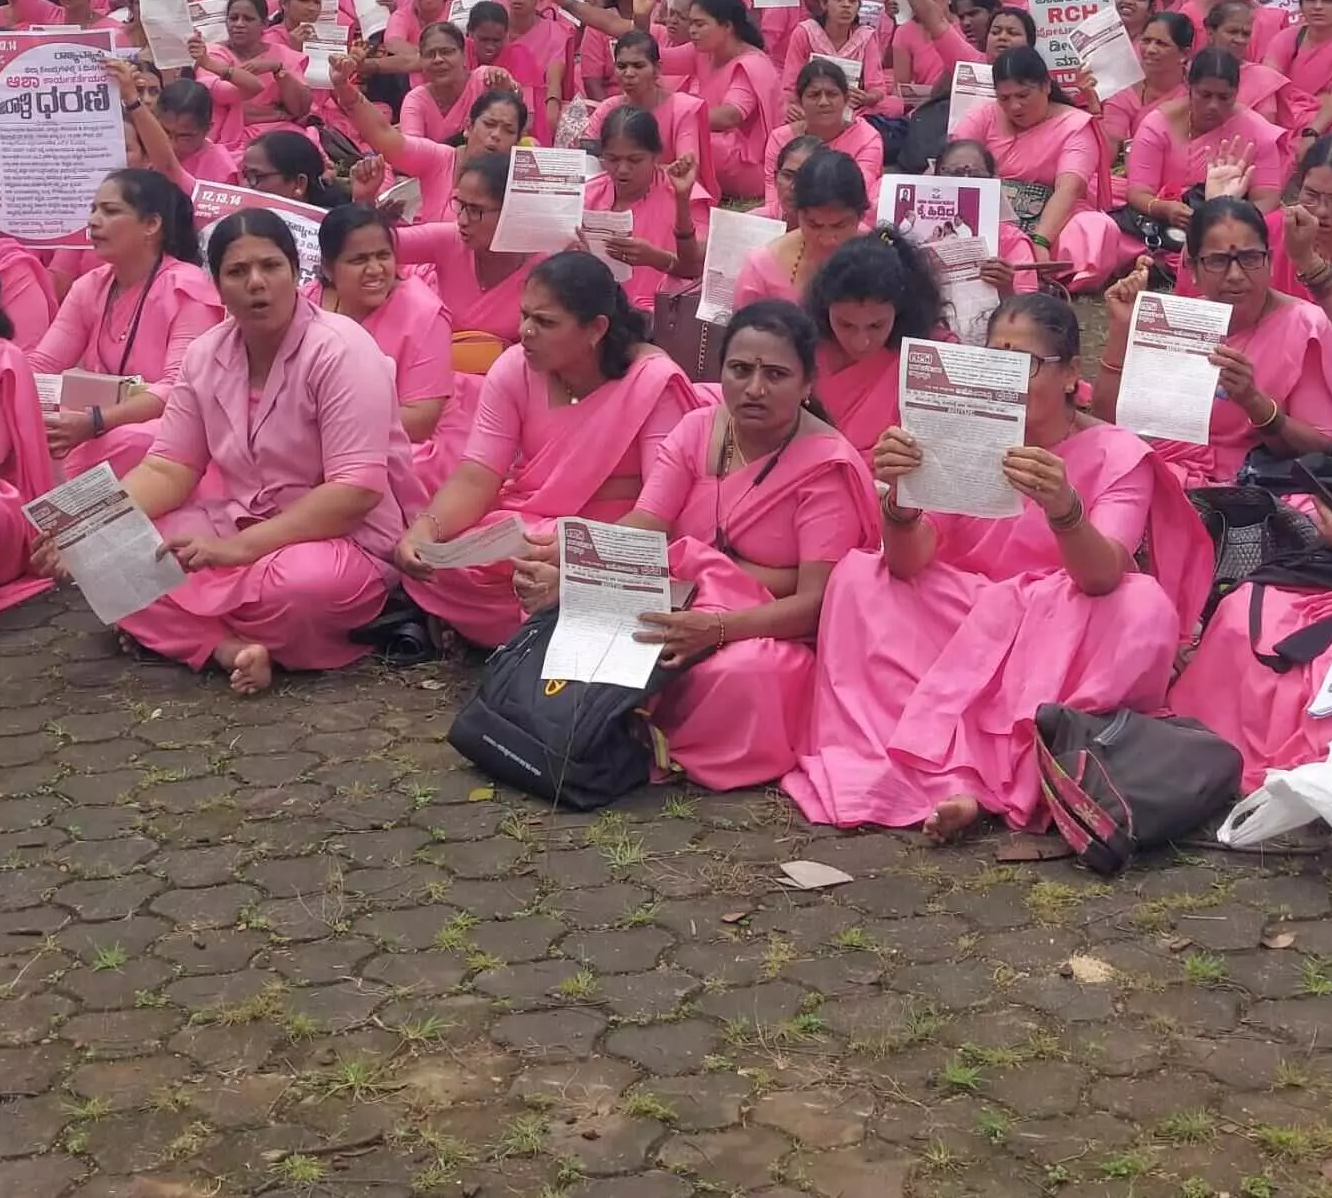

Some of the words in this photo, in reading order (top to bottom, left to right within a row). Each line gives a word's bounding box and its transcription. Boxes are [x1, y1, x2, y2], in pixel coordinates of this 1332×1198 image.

[1047, 3, 1098, 23] RCH
[6, 76, 40, 89] ಆಶಾ
[36, 83, 111, 119] ಧರಣಿ
